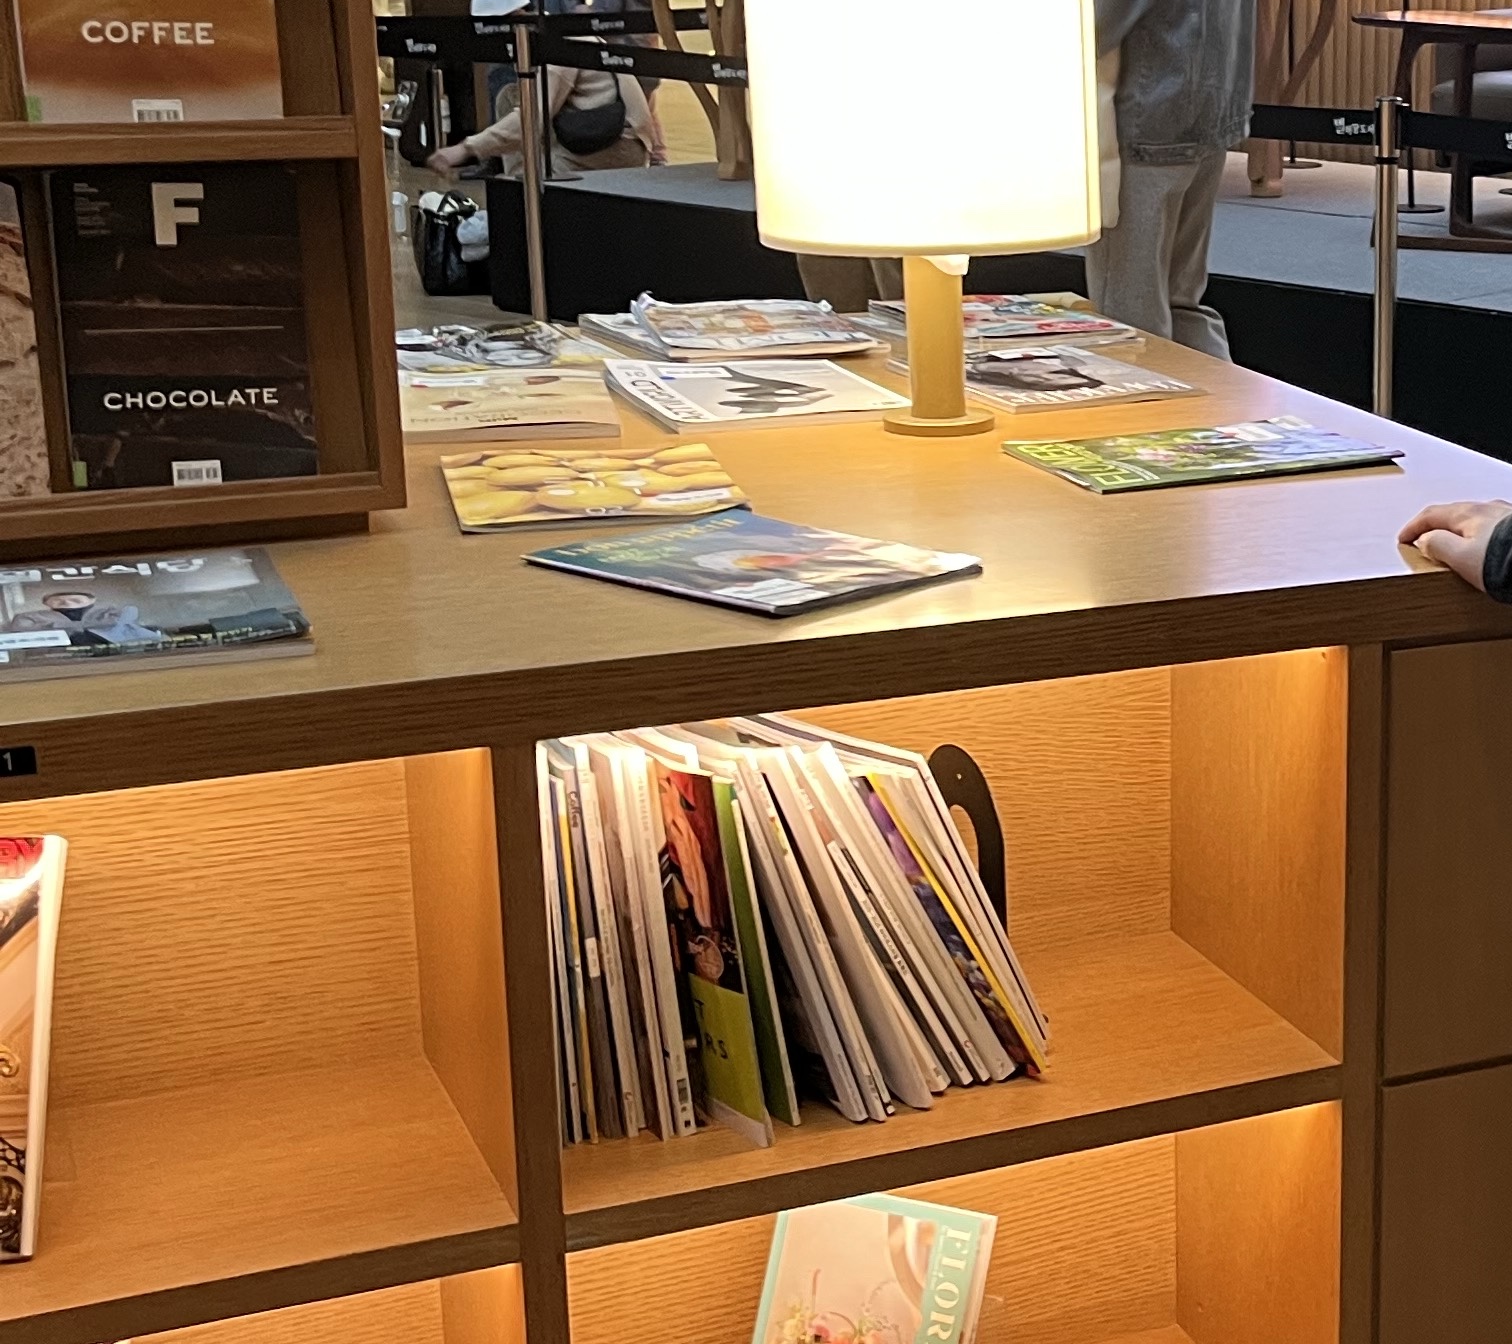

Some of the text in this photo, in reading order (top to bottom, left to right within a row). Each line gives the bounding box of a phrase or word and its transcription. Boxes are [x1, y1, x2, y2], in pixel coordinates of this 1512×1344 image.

[80, 20, 216, 46] COFFEE
[151, 181, 205, 248] F
[103, 387, 279, 411] CHOCOLATE
